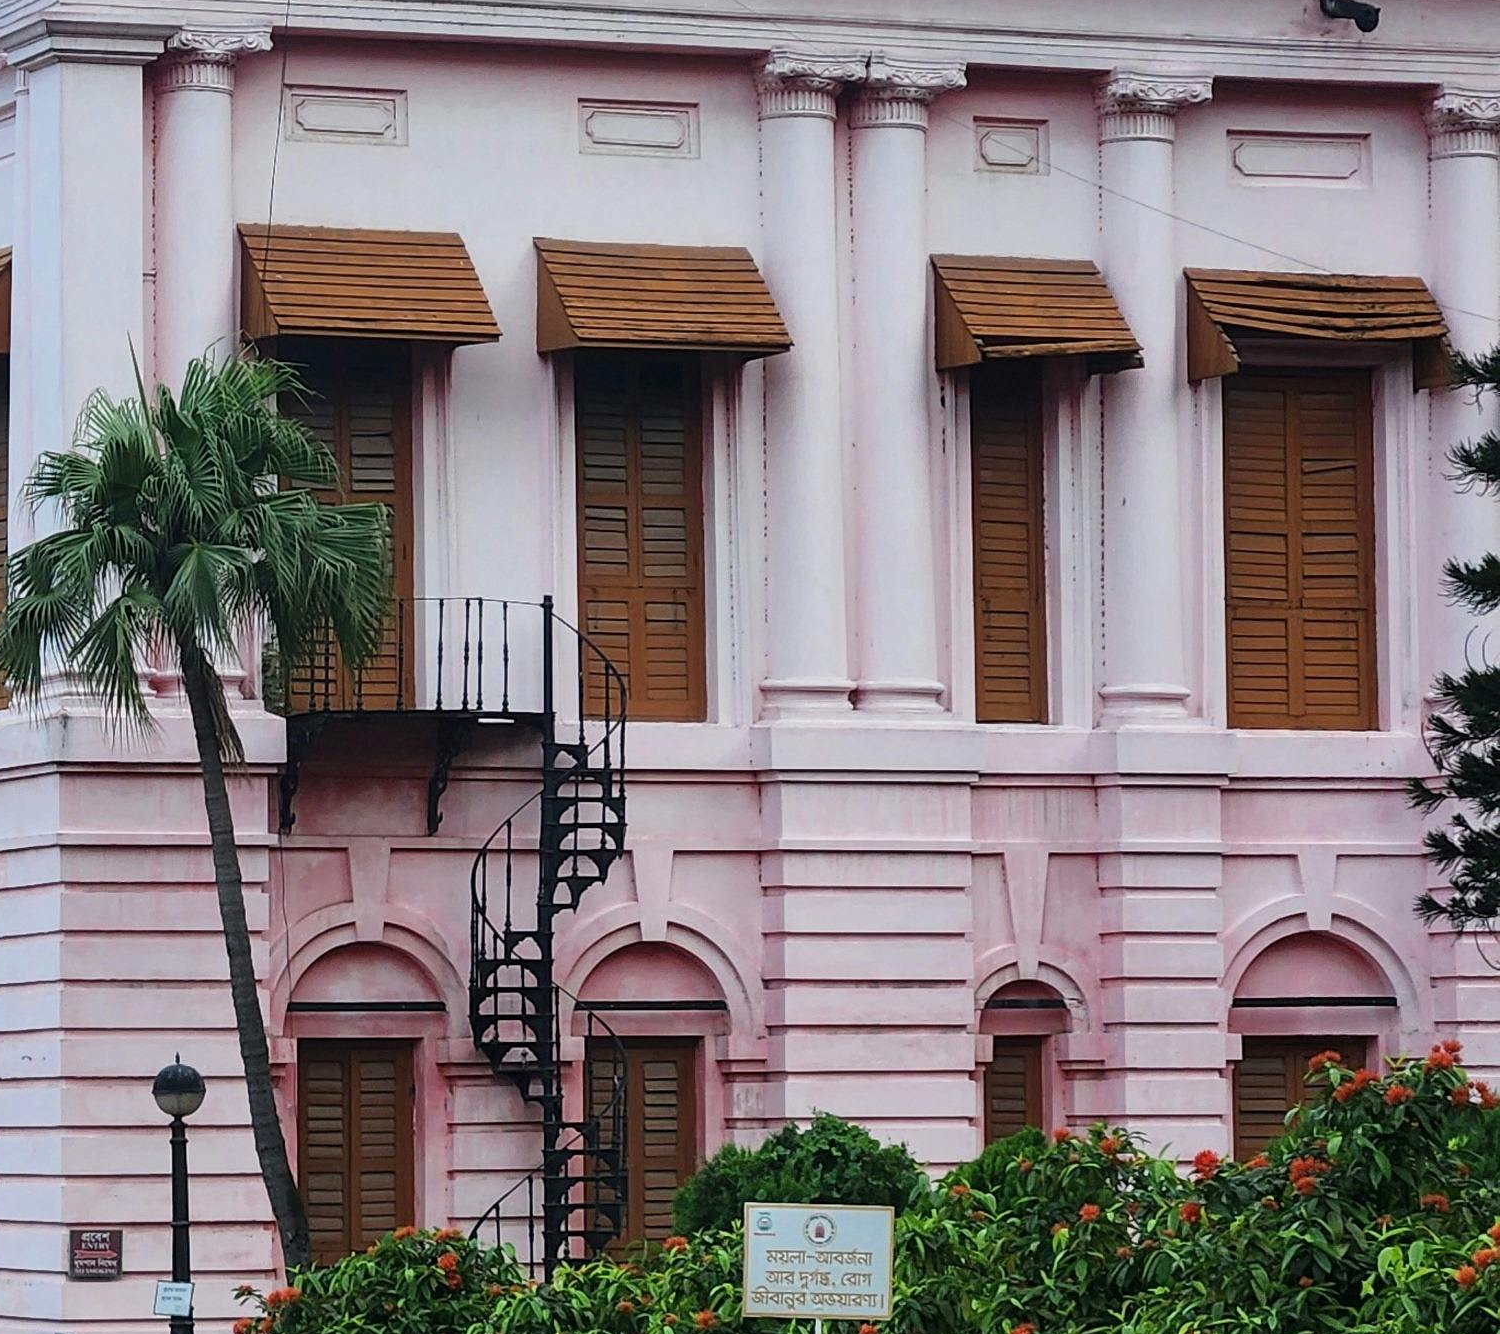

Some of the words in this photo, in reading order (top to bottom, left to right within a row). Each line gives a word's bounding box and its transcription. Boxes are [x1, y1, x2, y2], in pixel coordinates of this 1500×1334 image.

[81, 1242, 111, 1250] ENTRY
[765, 1270, 795, 1285] আর
[841, 1272, 873, 1287] রোগ
